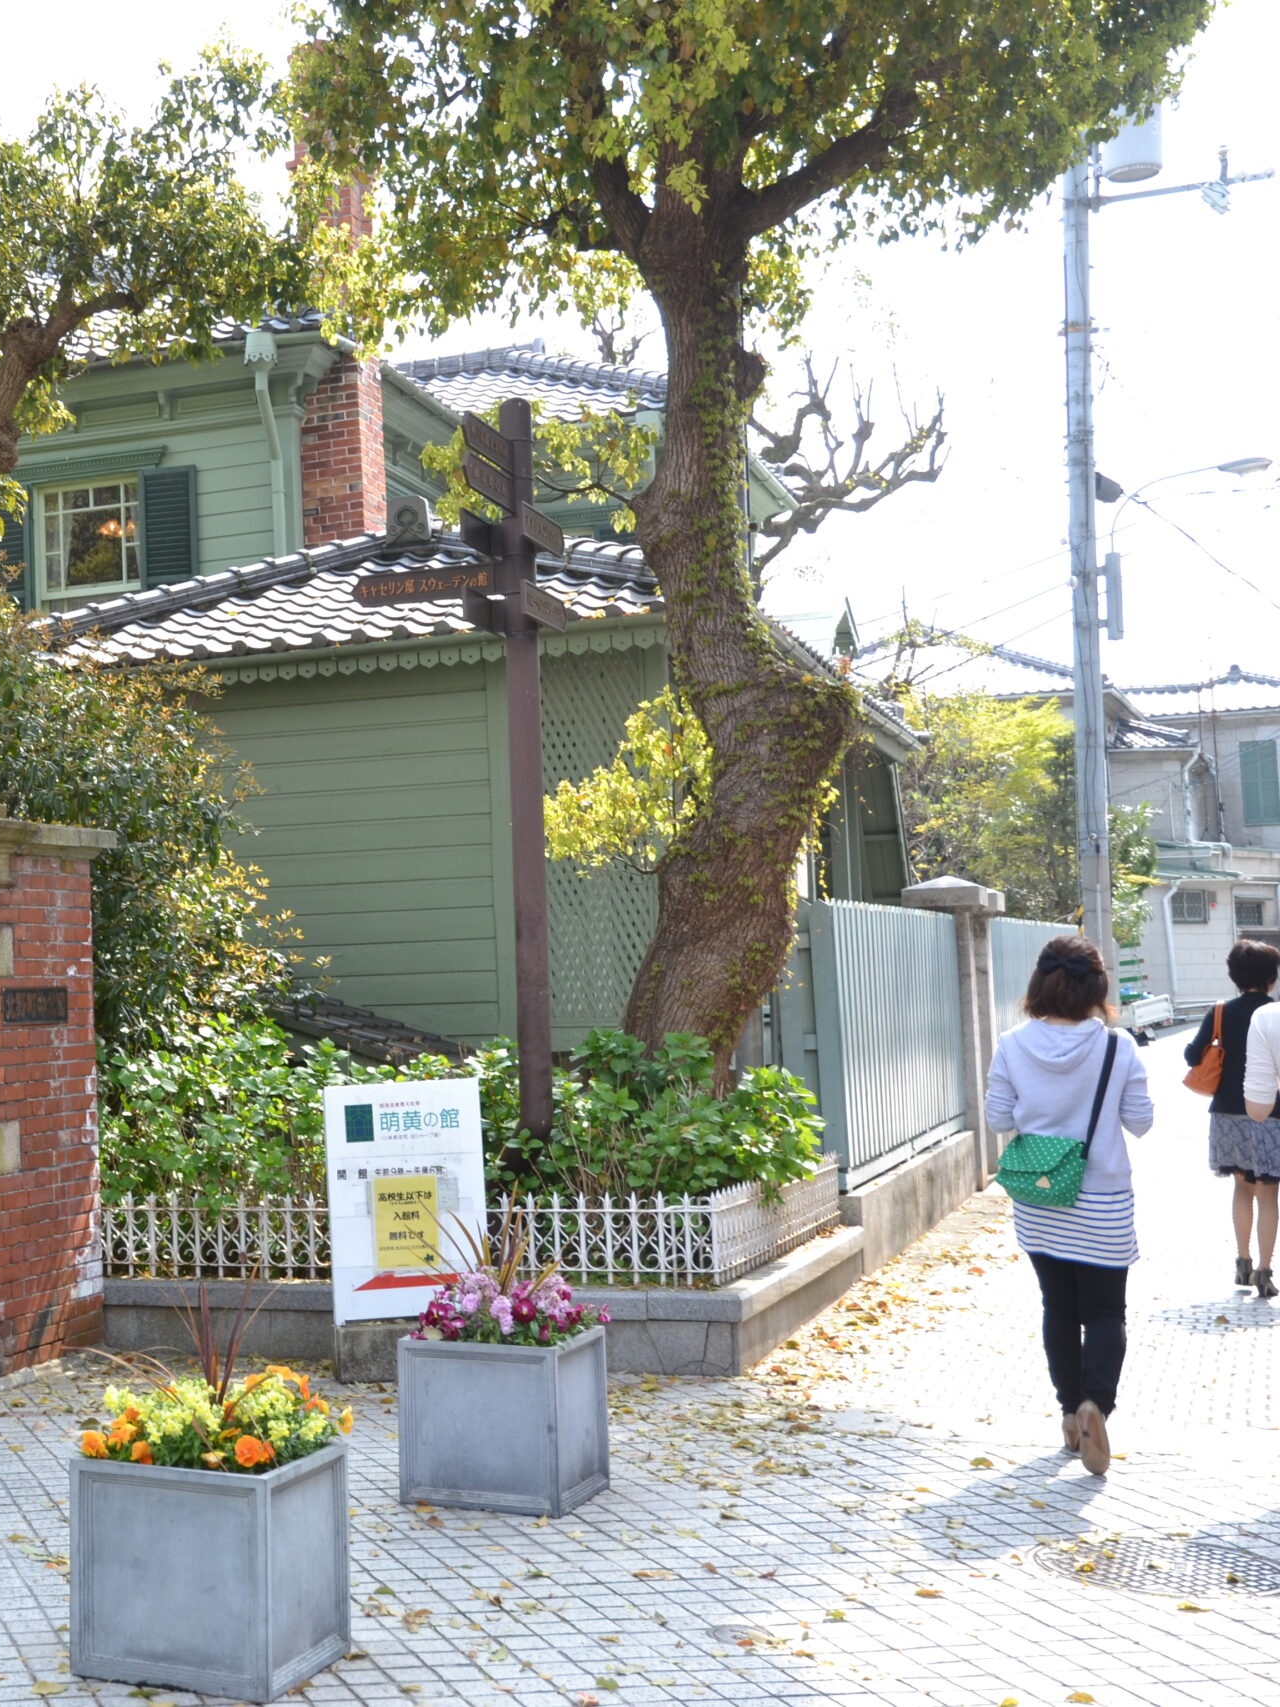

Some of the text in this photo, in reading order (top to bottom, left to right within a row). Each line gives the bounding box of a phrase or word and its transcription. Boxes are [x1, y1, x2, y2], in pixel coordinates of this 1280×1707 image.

[360, 571, 488, 598] キャセリン邸 スウェーデンの館
[379, 1108, 460, 1132] 萌黄の館
[378, 1190, 433, 1202] 高校生以下は
[393, 1210, 420, 1221] 入館料
[389, 1231, 425, 1241] 無料です
